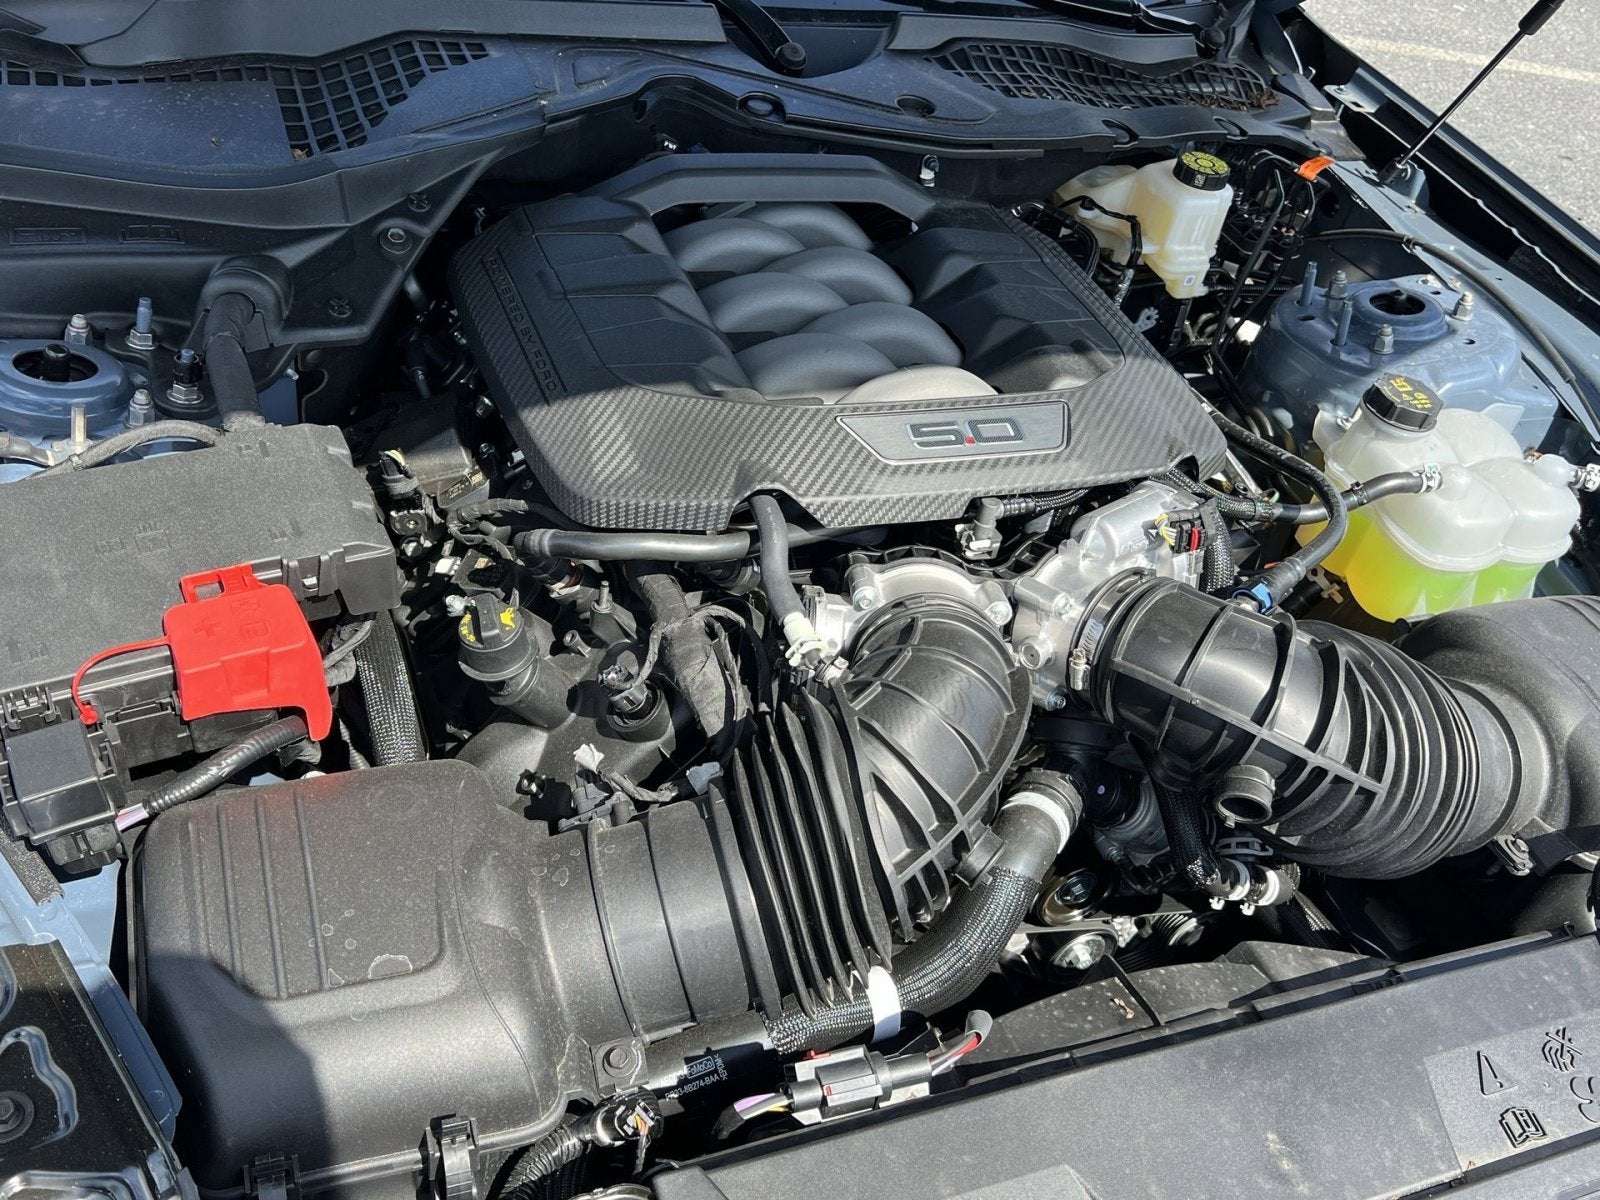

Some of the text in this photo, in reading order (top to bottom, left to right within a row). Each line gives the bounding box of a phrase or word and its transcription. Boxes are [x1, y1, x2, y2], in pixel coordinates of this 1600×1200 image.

[487, 256, 558, 392] POWERED BY FORD
[906, 418, 1024, 449] 5.0
[686, 1060, 713, 1076] FoMoCo
